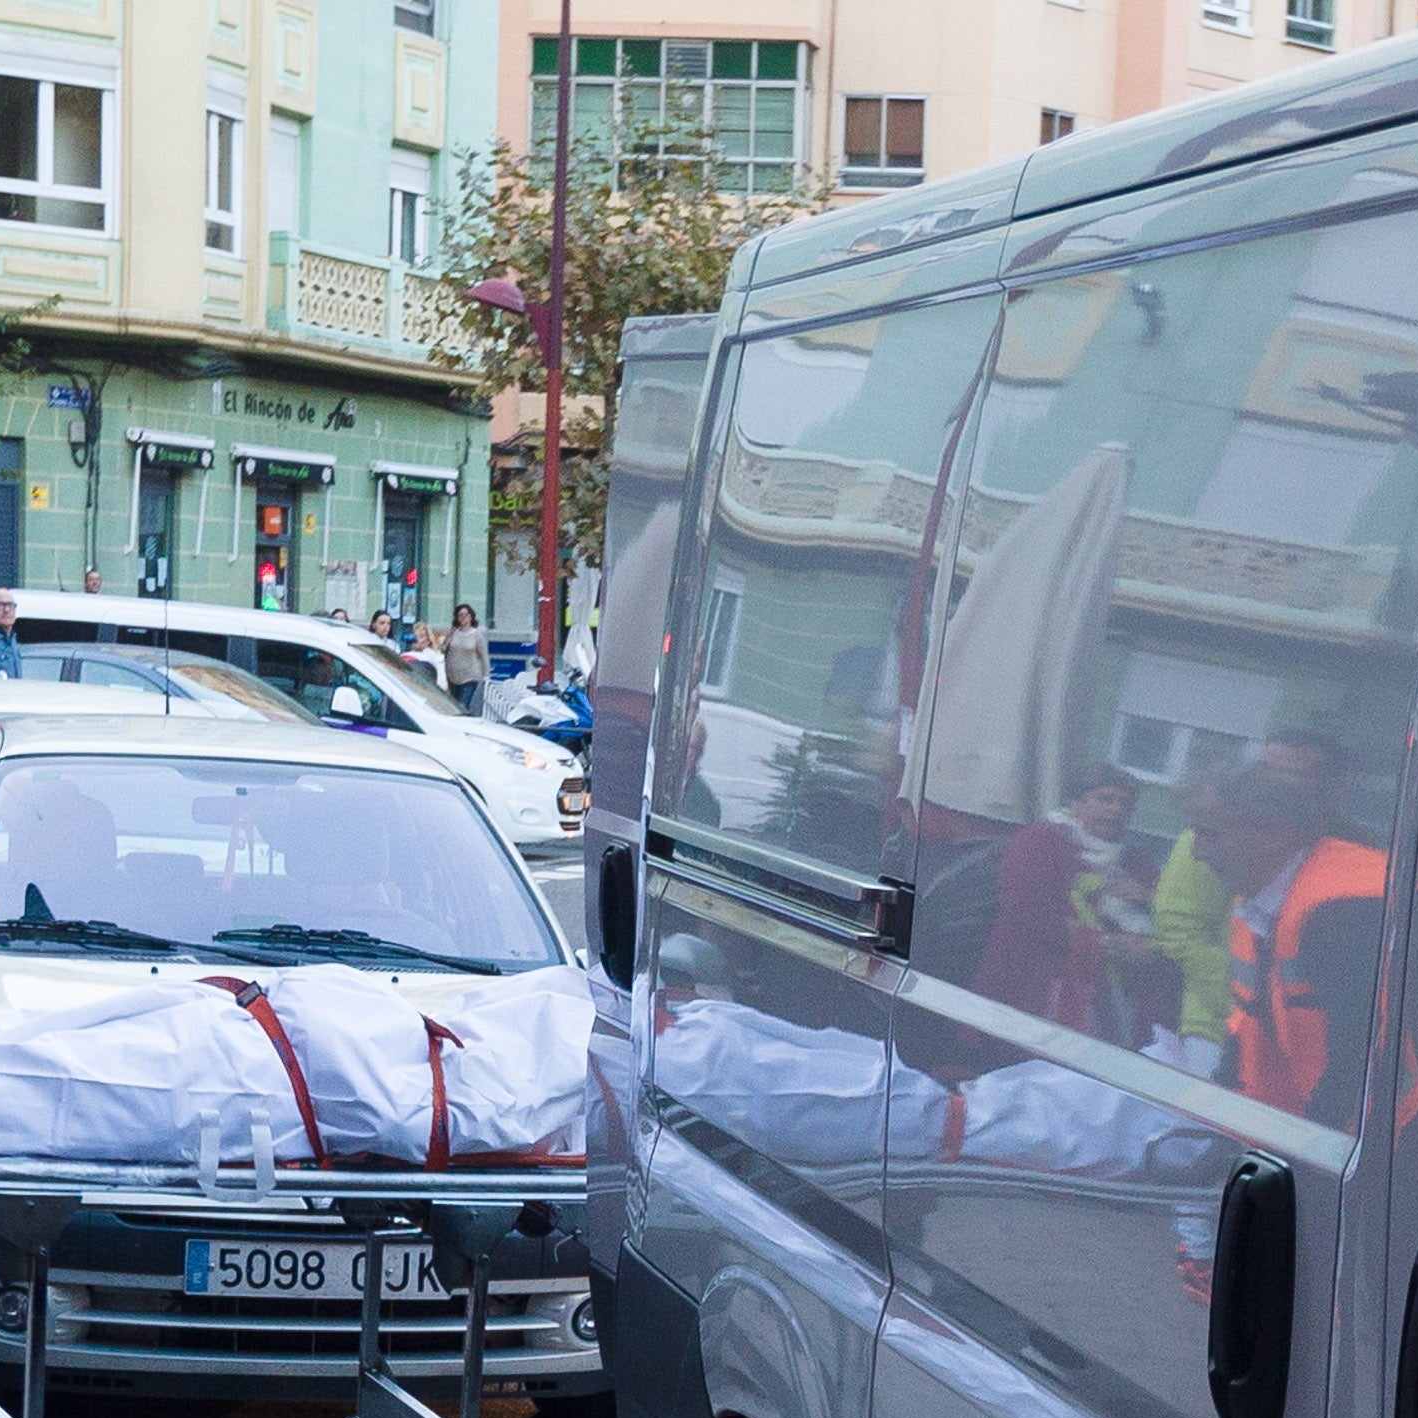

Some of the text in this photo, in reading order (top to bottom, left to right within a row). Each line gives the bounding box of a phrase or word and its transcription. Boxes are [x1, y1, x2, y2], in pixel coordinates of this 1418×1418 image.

[223, 390, 238, 412] El
[297, 401, 316, 423] de
[219, 1248, 326, 1291] 5098
